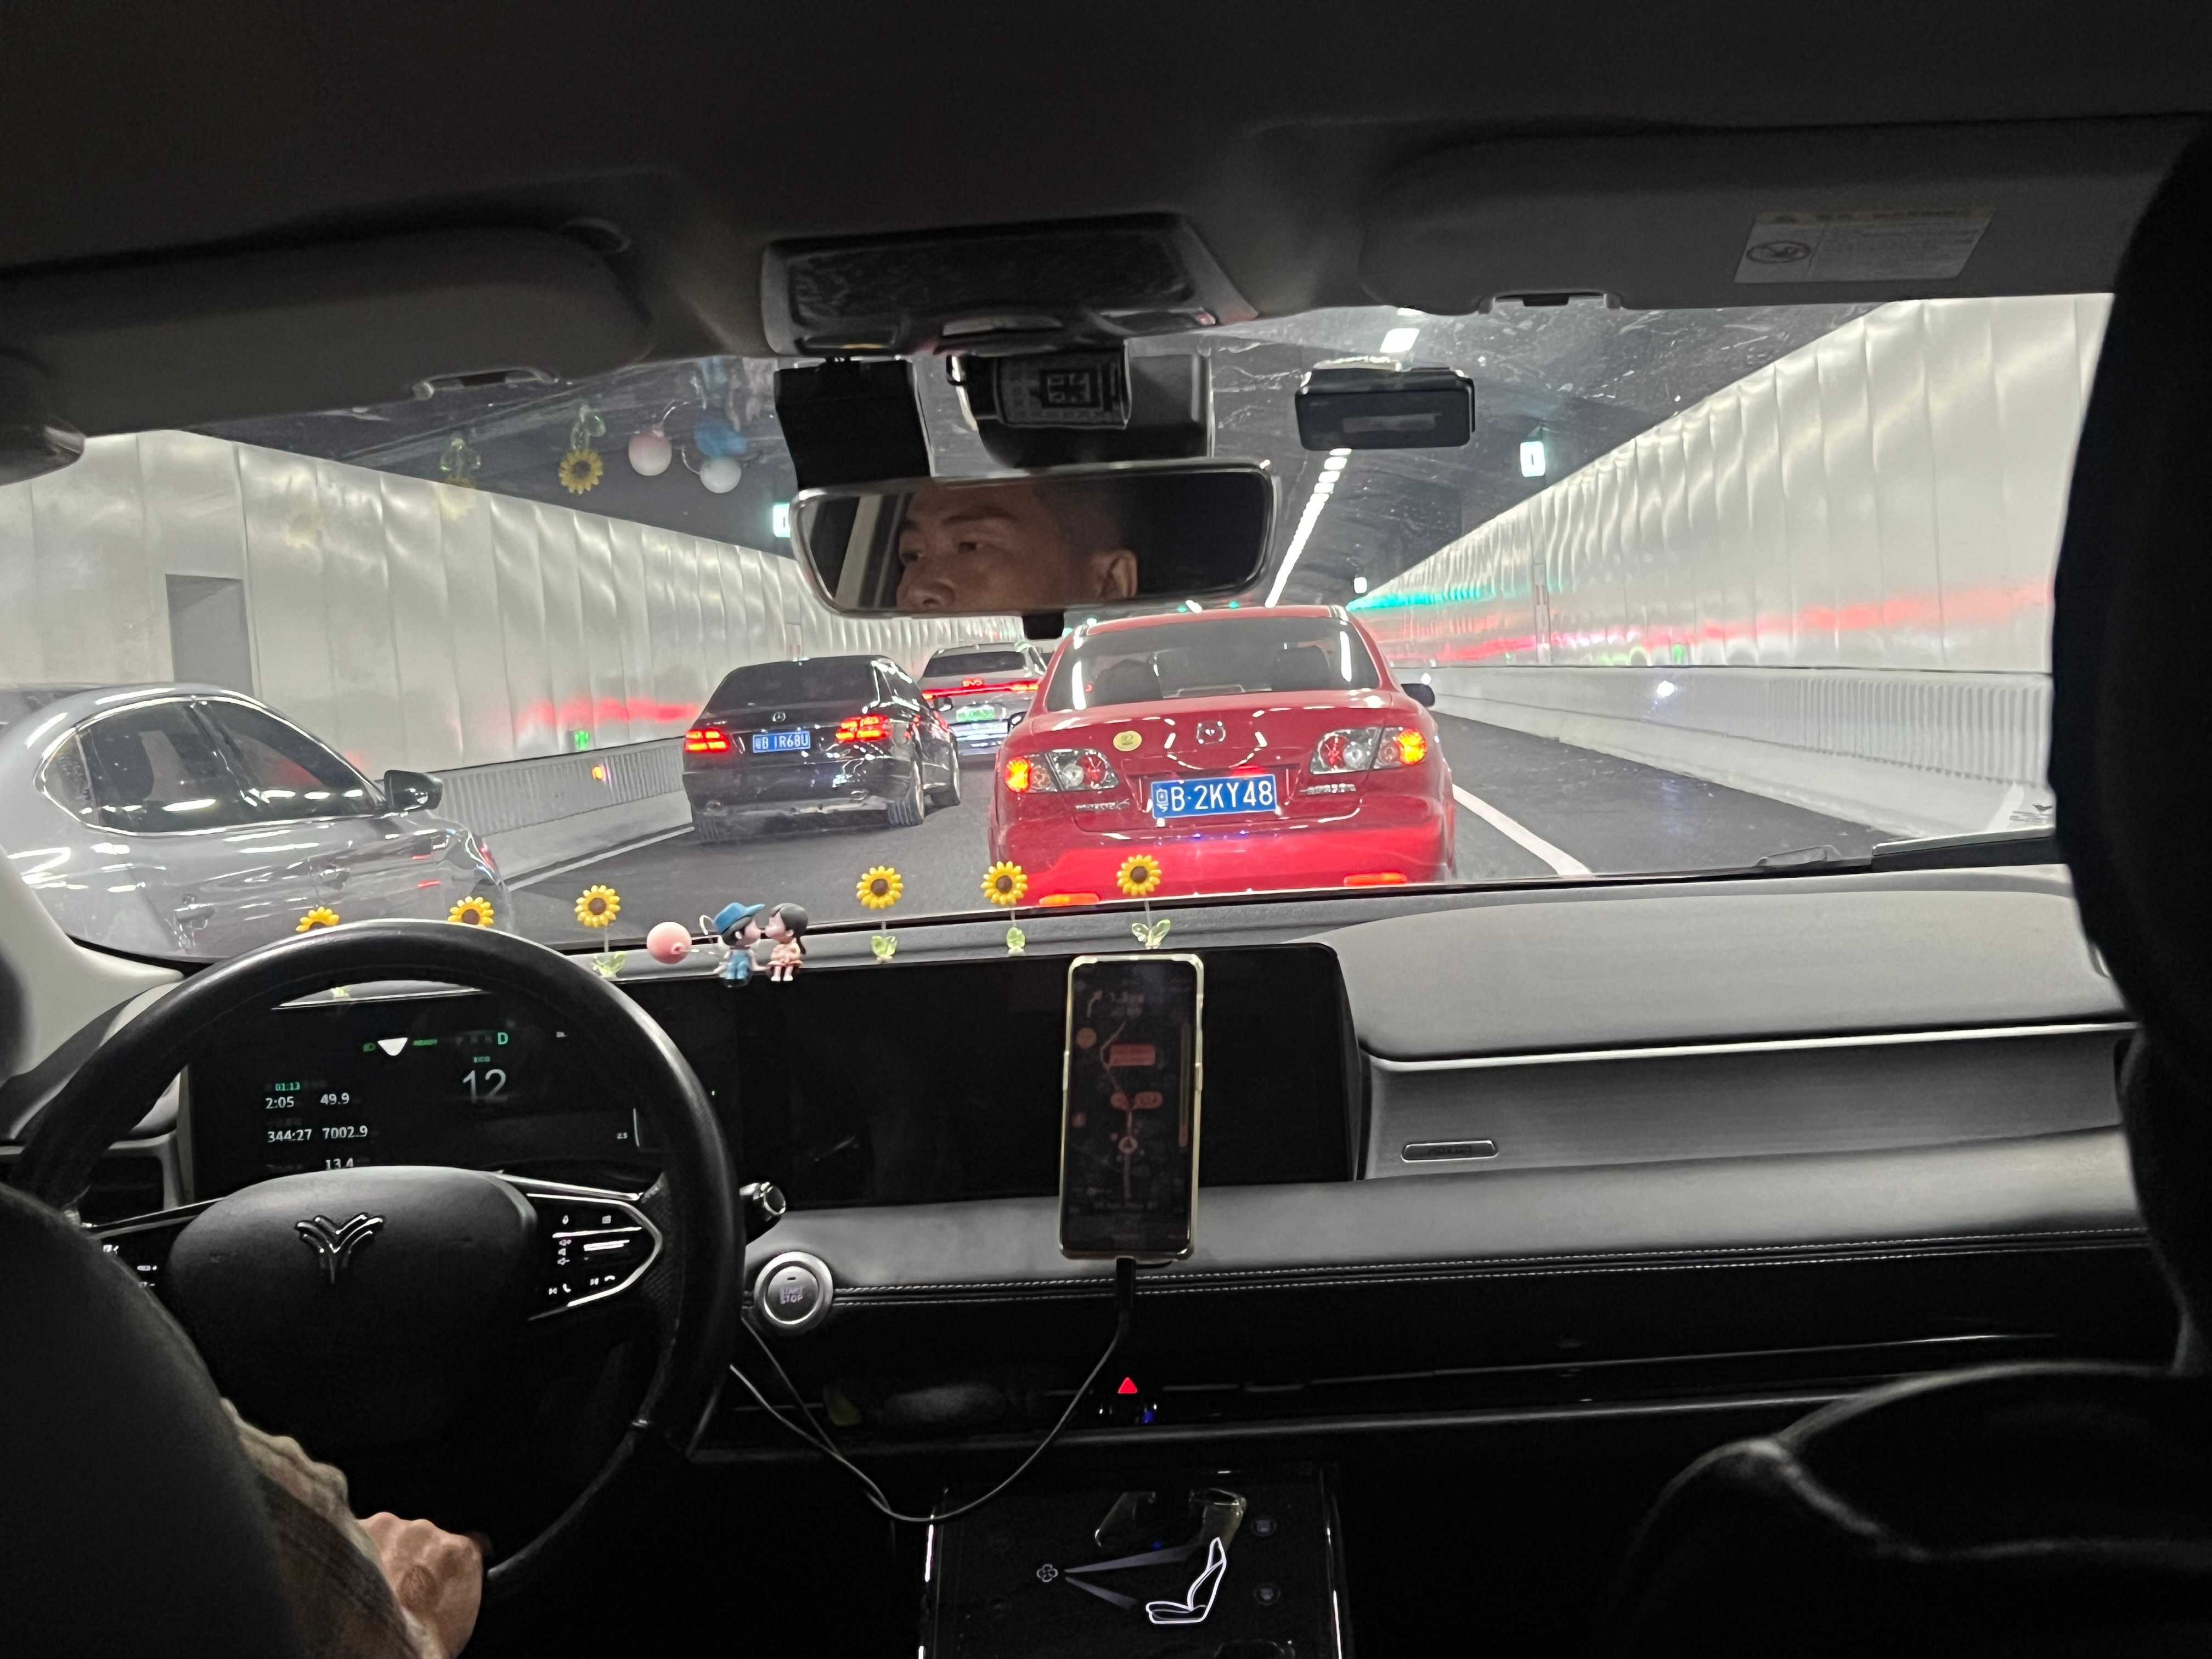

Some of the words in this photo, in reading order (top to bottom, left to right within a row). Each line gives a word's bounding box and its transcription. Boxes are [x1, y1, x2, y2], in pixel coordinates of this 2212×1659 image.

[498, 1032, 509, 1045] D
[462, 1069, 507, 1104] 12
[266, 1096, 295, 1109] 2:05
[320, 1092, 350, 1105] 49.9
[267, 1128, 312, 1143] 344:27
[321, 1125, 368, 1140] 7002.9
